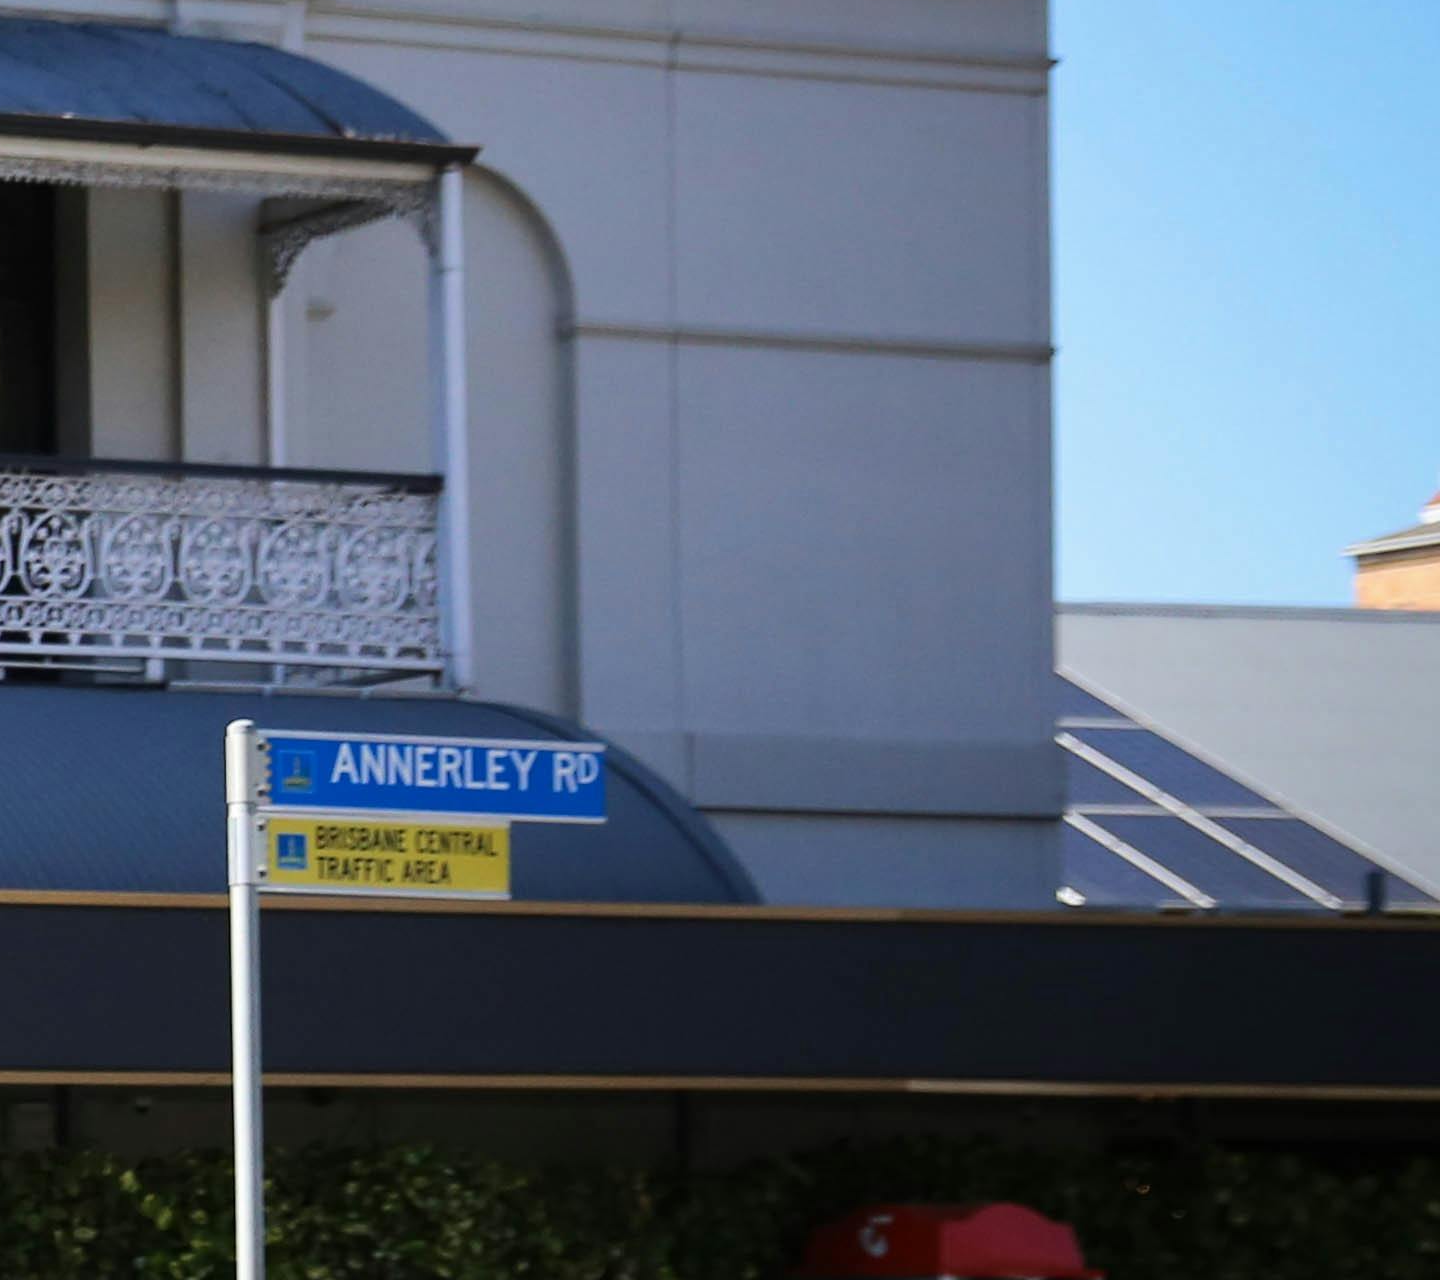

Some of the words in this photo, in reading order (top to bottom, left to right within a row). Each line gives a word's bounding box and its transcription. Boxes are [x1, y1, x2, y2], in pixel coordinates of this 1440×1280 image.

[331, 744, 537, 791] ANNERLEY
[552, 752, 598, 793] RD
[315, 825, 407, 853] BRISBANE
[414, 829, 498, 857] CENTRAL
[317, 856, 394, 882] TRAFFIC
[401, 859, 451, 883] AREA
